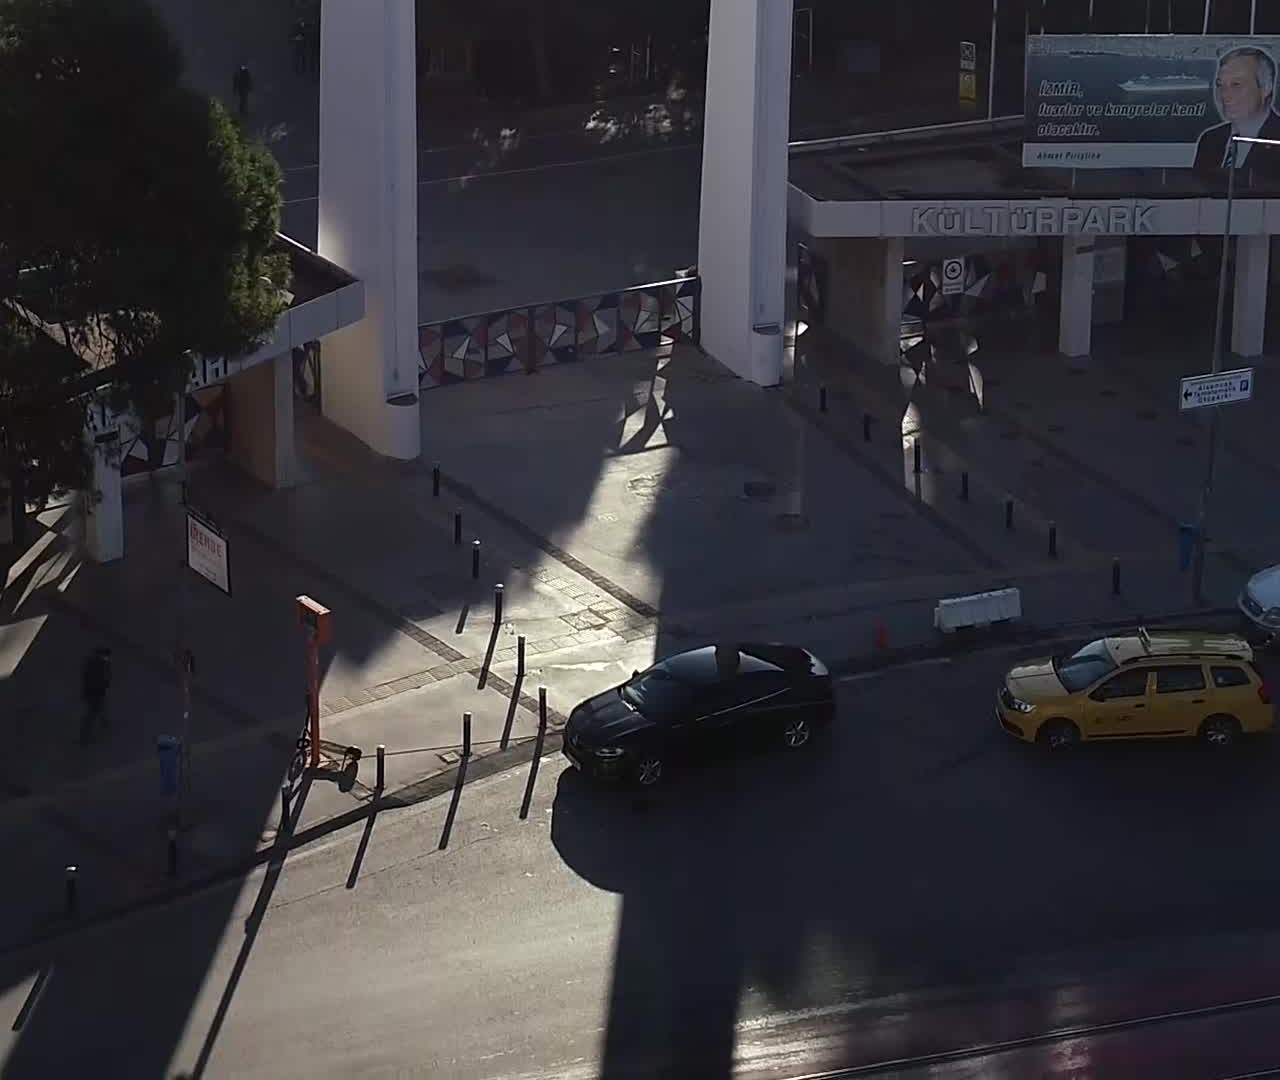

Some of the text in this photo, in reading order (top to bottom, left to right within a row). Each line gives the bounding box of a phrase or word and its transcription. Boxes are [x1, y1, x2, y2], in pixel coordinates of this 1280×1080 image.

[1086, 105, 1104, 117] ve
[1104, 101, 1170, 119] kongreler
[912, 205, 1160, 234] KÜLTÜRPARK
